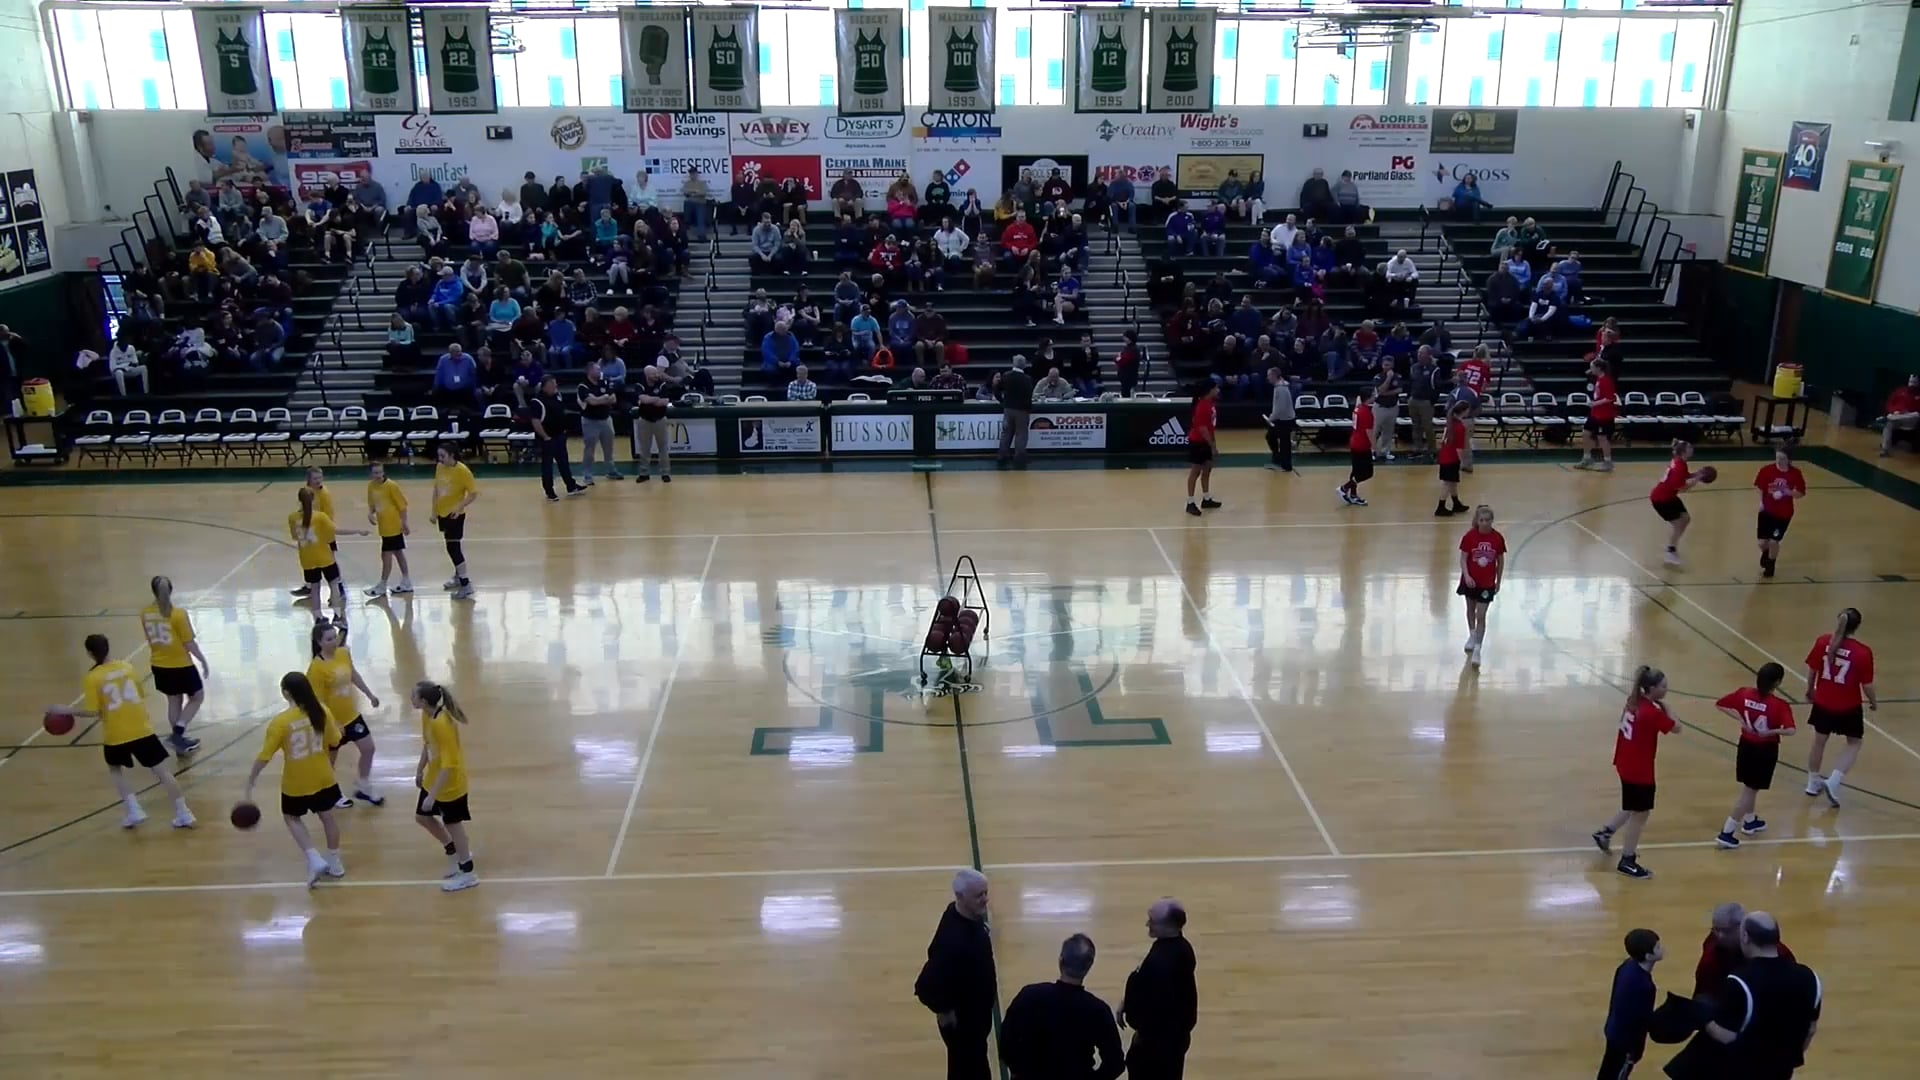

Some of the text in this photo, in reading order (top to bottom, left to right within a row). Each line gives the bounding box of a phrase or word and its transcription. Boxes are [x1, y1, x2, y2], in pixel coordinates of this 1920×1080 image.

[371, 52, 388, 67] 12
[448, 51, 469, 66] 22
[715, 50, 735, 65] 50
[860, 53, 880, 68] 20
[1101, 51, 1118, 66] 12
[1173, 51, 1189, 66] 13
[714, 95, 742, 106] 1990
[859, 98, 884, 109] 1991
[947, 96, 976, 108] 1993
[1095, 96, 1122, 106] 1995
[1166, 96, 1194, 106] 2010
[674, 112, 716, 124] Maine
[920, 112, 992, 128] CARON
[1180, 114, 1239, 131] Wight's
[674, 125, 726, 138] Savings
[740, 122, 811, 134] VARNEY
[1121, 122, 1176, 136] Creative
[1794, 144, 1816, 167] 40
[670, 158, 729, 174] RESERVE
[825, 158, 907, 168] CENTRAL MAINE
[1391, 156, 1415, 170] PG
[1352, 171, 1389, 181] Portland
[1055, 416, 1104, 425] DORR'S
[834, 420, 911, 443] HUSSON
[1149, 432, 1190, 445] adidas
[1821, 654, 1851, 685] 17
[102, 679, 141, 711] 34
[1744, 710, 1768, 735] 14
